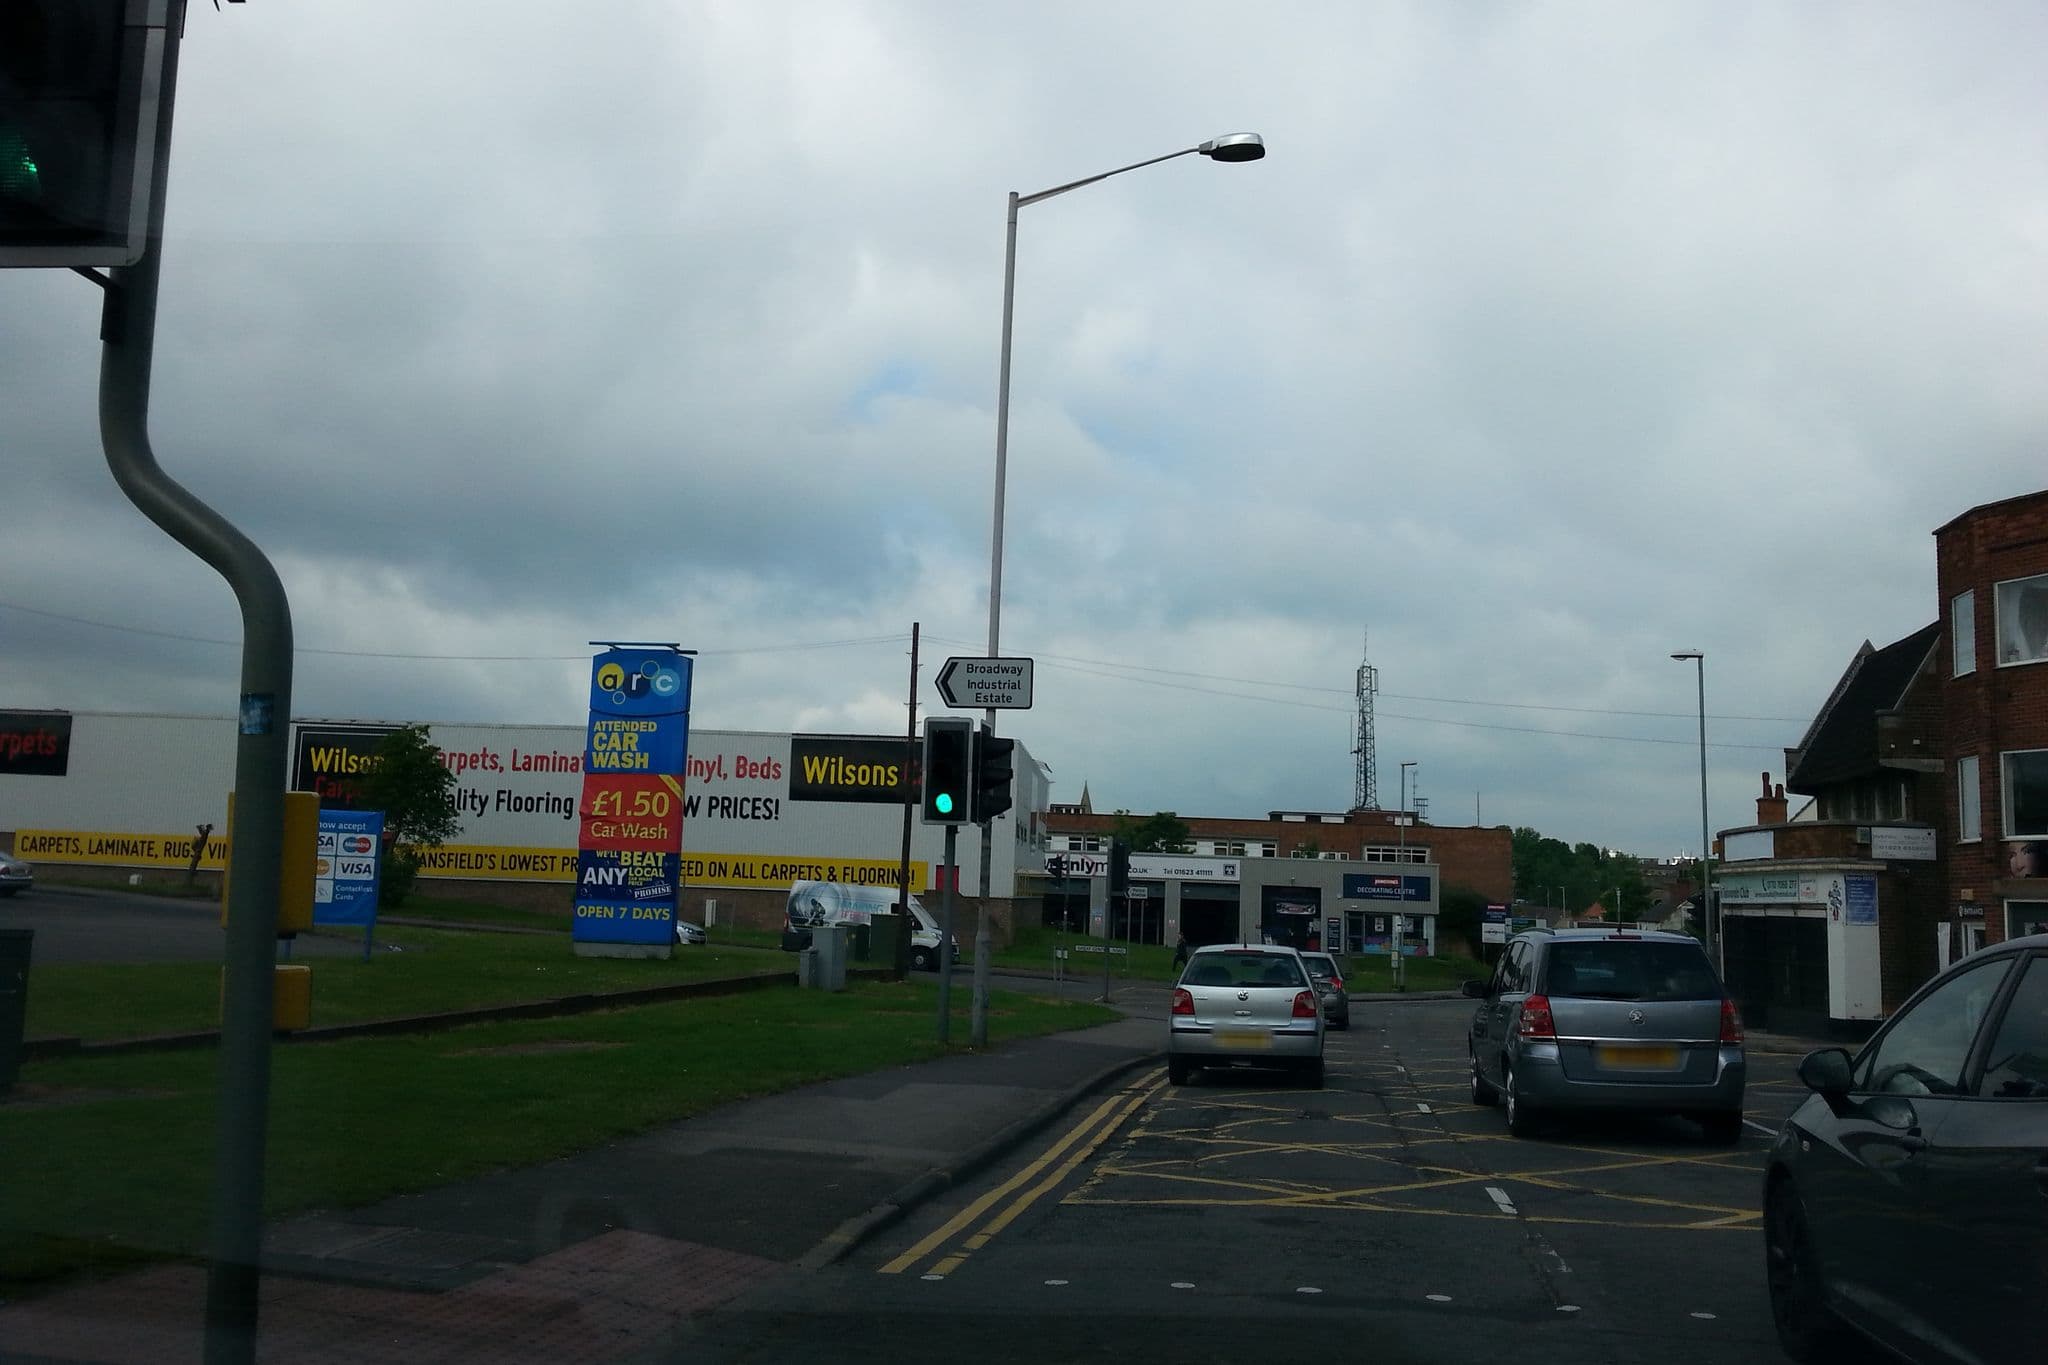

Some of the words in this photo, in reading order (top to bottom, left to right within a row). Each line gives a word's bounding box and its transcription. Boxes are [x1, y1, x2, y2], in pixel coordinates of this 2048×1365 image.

[966, 663, 1023, 676] Broadway
[602, 673, 673, 692] arc
[967, 679, 1021, 690] Industrial
[975, 693, 1013, 703] Estate
[593, 720, 657, 732] ATTENDED
[593, 732, 639, 752] CAR
[512, 748, 586, 773] Lamina
[736, 755, 782, 780] Beds
[592, 752, 649, 769] WASH
[803, 755, 899, 787] Wilsons
[496, 789, 574, 820] Flooring
[708, 796, 779, 820] PRICES!
[591, 790, 670, 817] £1.50
[338, 822, 367, 833] accept
[591, 822, 617, 838] Car
[621, 823, 668, 839] Wash
[20, 836, 83, 856] CARPETS,
[88, 838, 159, 859] LAMINATE,
[620, 851, 666, 867] BEAT
[341, 863, 372, 874] VISA
[501, 854, 557, 872] LOWEST
[709, 861, 728, 878] ON
[732, 862, 757, 879] ALL
[762, 863, 823, 881] CARPETS
[828, 866, 838, 882] &
[583, 867, 628, 886] ANY
[628, 867, 665, 877] LOCAL
[634, 885, 672, 899] PROMISE
[1356, 886, 1393, 895] DECORATING
[577, 905, 614, 918] OPEN
[619, 907, 628, 918] 7
[632, 907, 671, 920] DAYS
